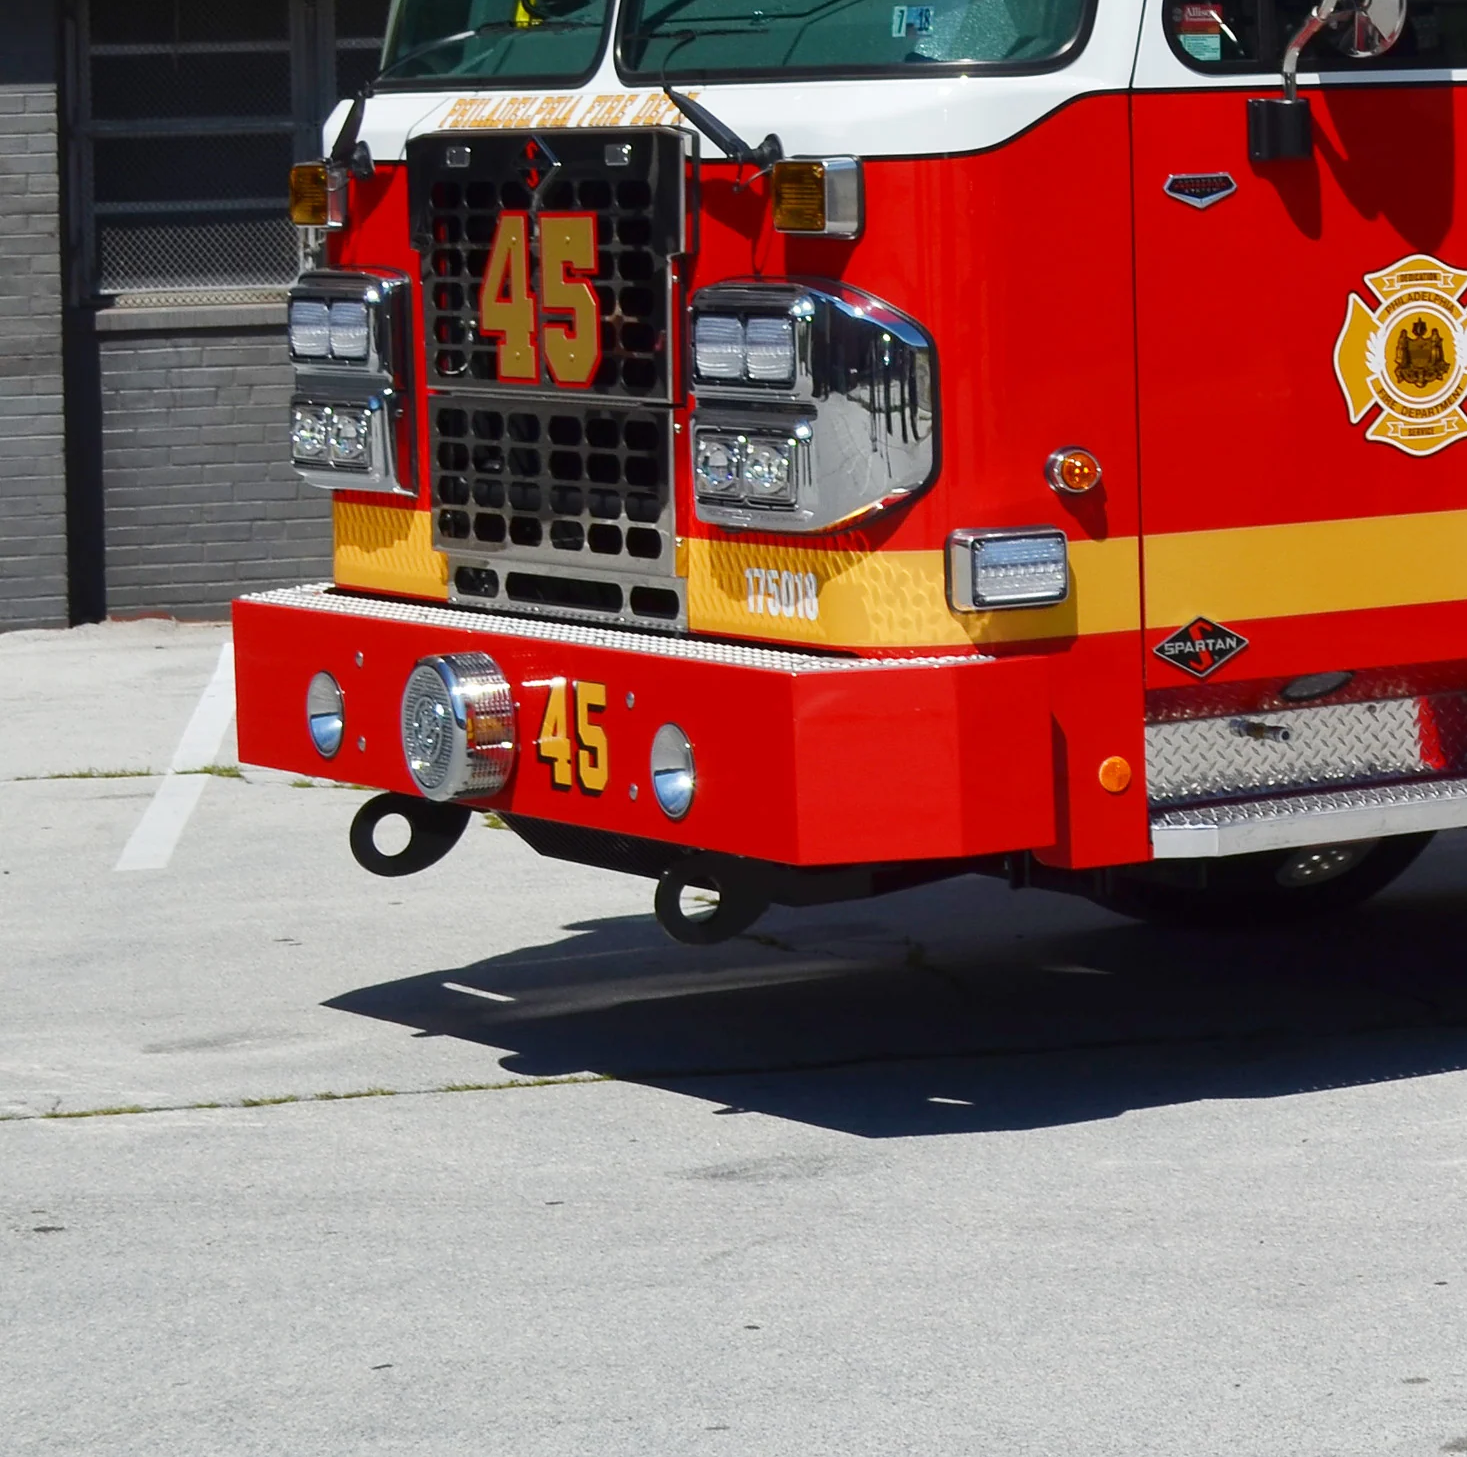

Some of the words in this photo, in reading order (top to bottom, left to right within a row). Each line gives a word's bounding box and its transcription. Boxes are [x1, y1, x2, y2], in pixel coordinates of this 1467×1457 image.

[577, 94, 639, 127] FIRE
[478, 209, 603, 389] 45
[1385, 291, 1455, 315] PHILADELPHIA
[1377, 388, 1397, 411] FIRE
[1400, 384, 1464, 419] DEPARTMENT
[745, 567, 819, 621] 175018
[1164, 637, 1238, 655] SPARTAN
[536, 679, 610, 796] 45
